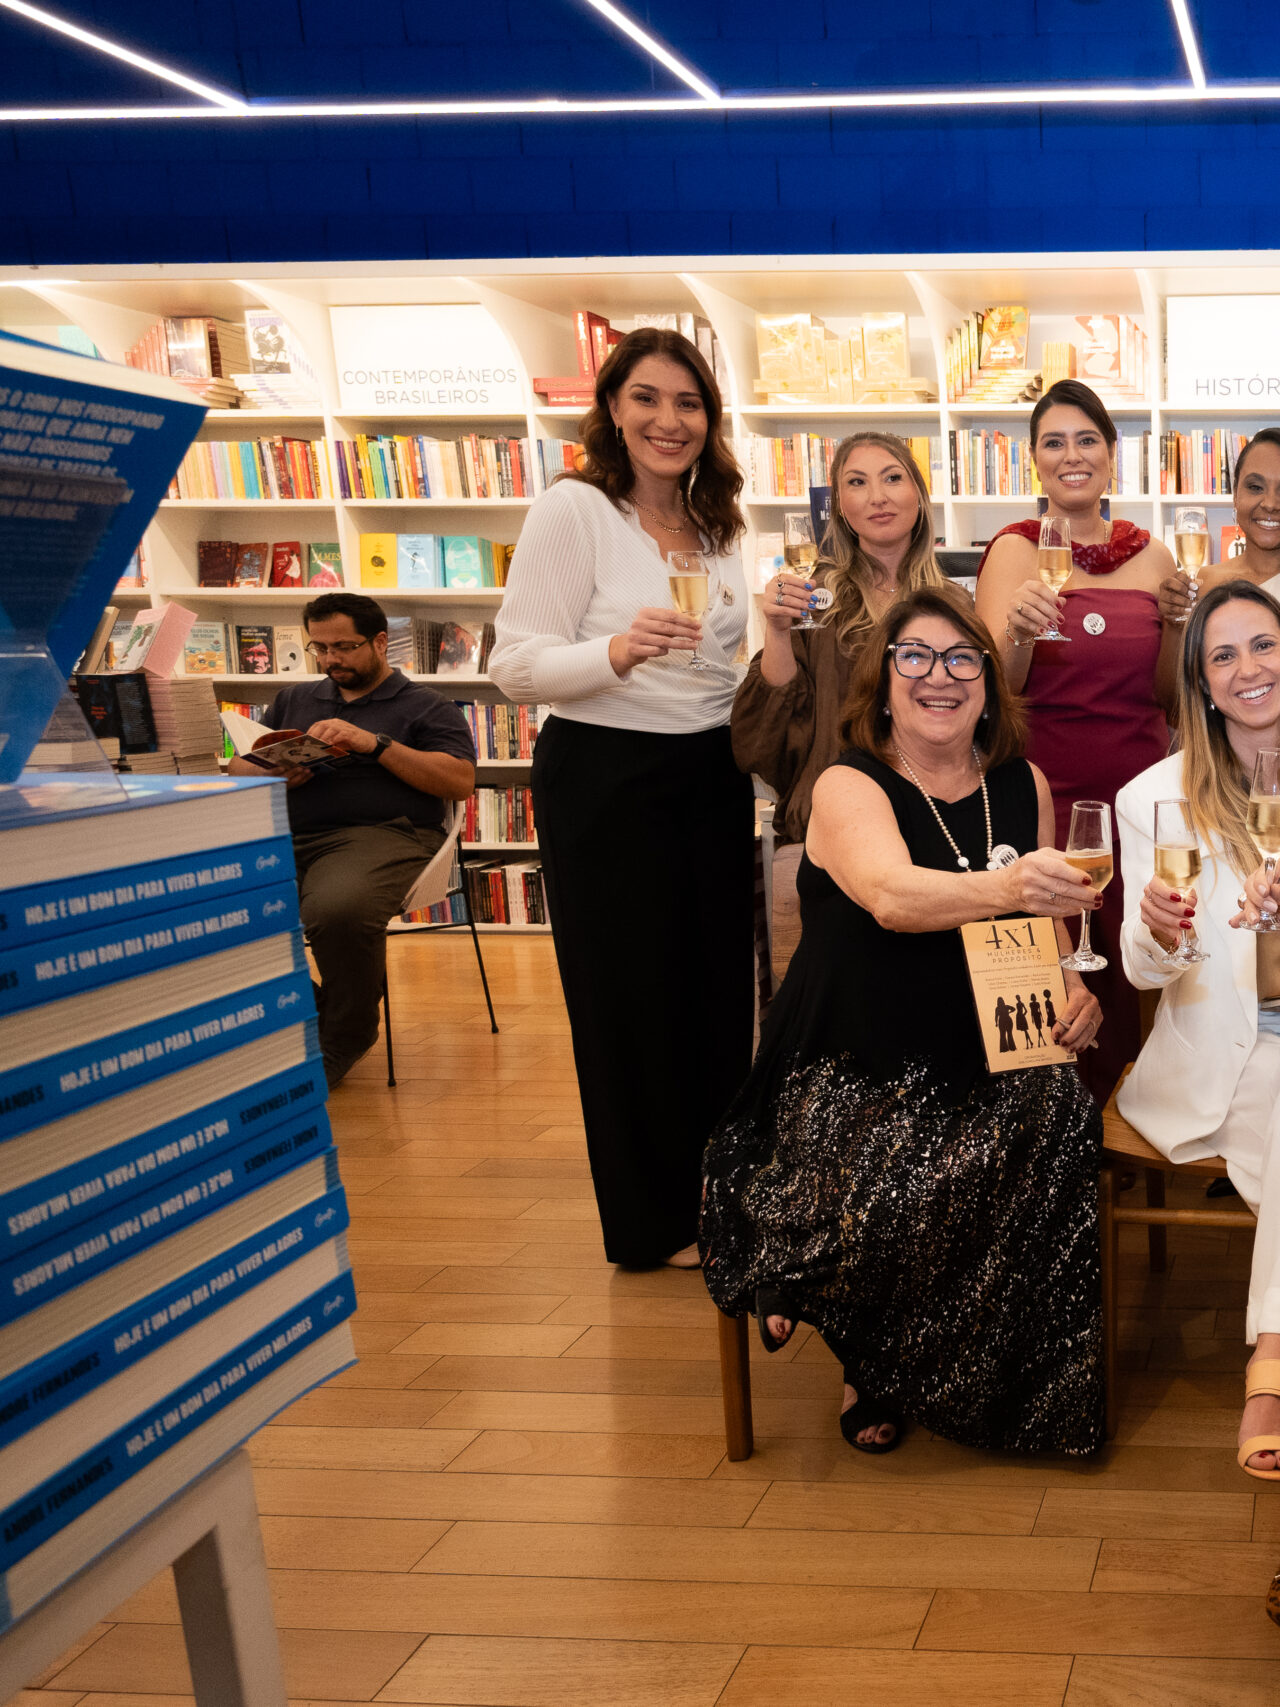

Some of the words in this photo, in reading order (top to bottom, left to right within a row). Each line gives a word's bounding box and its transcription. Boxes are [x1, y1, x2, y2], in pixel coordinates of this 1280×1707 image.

[343, 366, 517, 385] CONTEMPORÂNEOS
[375, 389, 489, 404] BRASILEIROS
[25, 902, 58, 926] HOJE
[59, 898, 67, 917] É
[68, 896, 88, 916] UM
[89, 890, 114, 911] BOM
[115, 885, 135, 905] DIA
[136, 879, 166, 900] PARA
[166, 871, 197, 893] VIVER
[196, 863, 243, 887] MILAGRES
[35, 957, 68, 981] HOJE
[69, 952, 76, 972] É
[78, 950, 97, 969] UM
[98, 943, 123, 964] BOM
[124, 937, 144, 957] DIA
[145, 929, 174, 950] PARA
[174, 920, 204, 943] VIVER
[204, 908, 250, 936] MILAGRES
[986, 948, 1033, 958] MULHERES
[992, 954, 1042, 964] PROPÓSITO
[60, 1067, 92, 1093] HOJE
[92, 1060, 100, 1081] É
[101, 1057, 119, 1078] UM
[120, 1048, 144, 1070] BOM
[145, 1042, 164, 1061] DIA
[165, 1030, 192, 1053] PARA
[193, 1020, 222, 1042] VIVER
[222, 1004, 265, 1031] MILAGRES
[240, 1092, 288, 1125] FERNANDES
[180, 1133, 197, 1153] UM
[204, 1119, 229, 1142] HOJE
[137, 1153, 157, 1174] DIA
[156, 1141, 180, 1165] BOM
[244, 1140, 292, 1174] FERNANDES
[105, 1162, 136, 1189] PARA
[208, 1169, 233, 1194] HOJE
[69, 1177, 105, 1206] VIVER
[184, 1185, 201, 1206] UM
[8, 1194, 70, 1236] MILAGRES
[141, 1207, 160, 1229] DIA
[160, 1194, 184, 1218] BOM
[109, 1216, 141, 1244] PARA
[74, 1233, 110, 1263] VIVER
[12, 1252, 75, 1296] MILAGRES
[114, 1326, 143, 1354] HOJE
[151, 1311, 169, 1334] UM
[169, 1299, 192, 1322] BOM
[192, 1287, 210, 1309] DIA
[210, 1268, 236, 1294] PARA
[237, 1254, 264, 1278] VIVER
[263, 1227, 304, 1260] MILAGRES
[47, 1456, 114, 1514] FERNANDES
[125, 1429, 157, 1457] HOJE
[162, 1409, 181, 1433] UM
[181, 1392, 203, 1419] BOM
[202, 1377, 220, 1404] DIA
[220, 1361, 247, 1390] PARA
[246, 1343, 273, 1373] VIVER
[273, 1316, 313, 1355] MILAGRES
